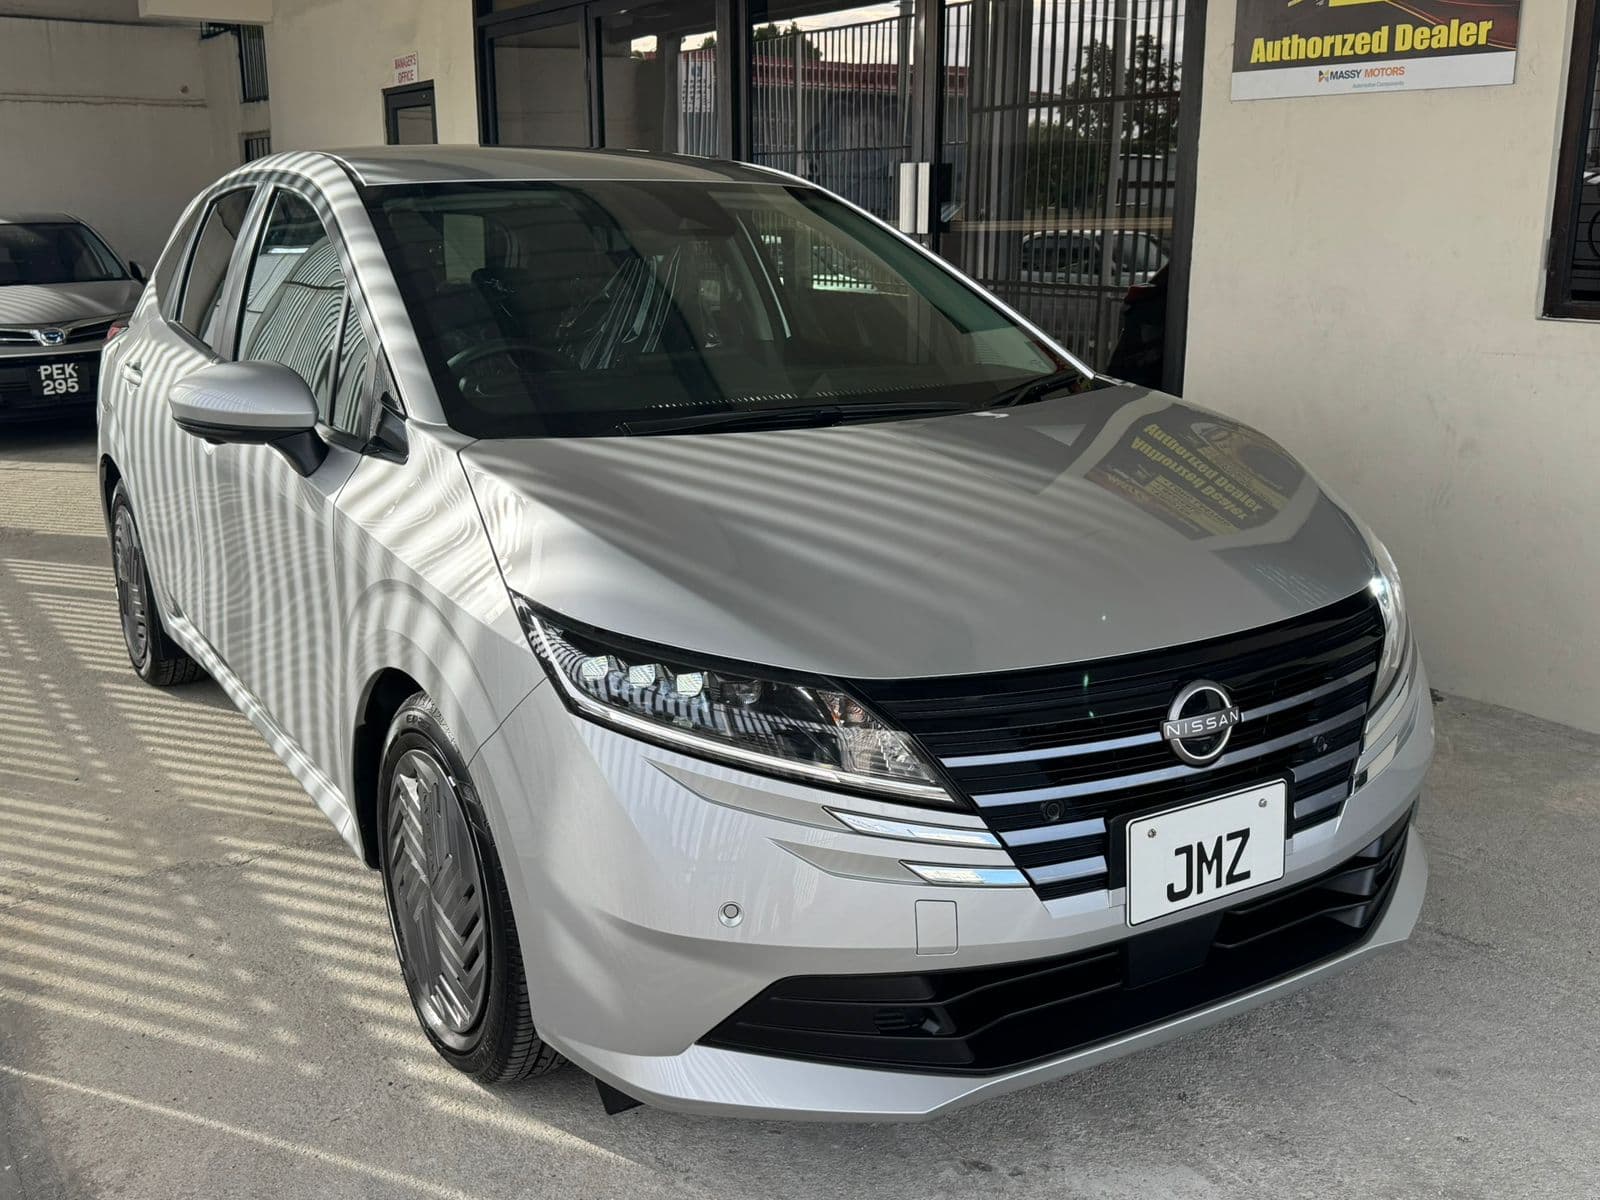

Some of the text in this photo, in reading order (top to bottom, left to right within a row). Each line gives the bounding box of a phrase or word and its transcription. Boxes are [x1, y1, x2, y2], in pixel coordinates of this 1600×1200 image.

[1250, 18, 1493, 64] Authorized Dealer
[1329, 66, 1406, 81] MASSY MOTORS
[40, 363, 78, 380] PEK
[42, 378, 79, 395] 295
[1165, 709, 1240, 738] NISSAN
[1166, 827, 1251, 903] JMZ
